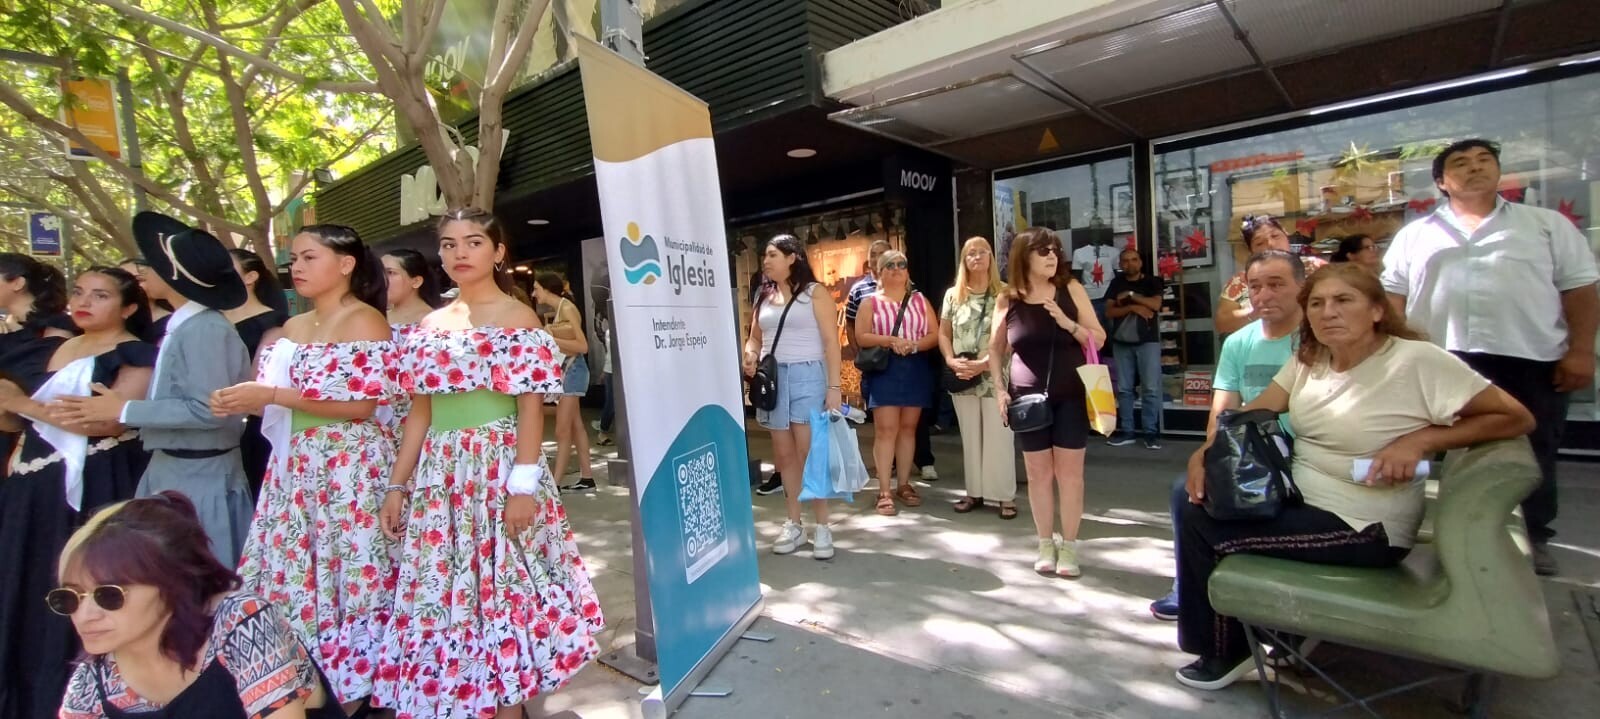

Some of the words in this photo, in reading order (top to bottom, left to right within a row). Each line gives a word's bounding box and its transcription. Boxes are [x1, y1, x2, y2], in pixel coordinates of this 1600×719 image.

[900, 169, 937, 191] MOOV
[664, 236, 706, 255] Municipalidad
[667, 253, 715, 296] Iglesia
[652, 316, 686, 331] Intendente
[654, 334, 668, 349] Dr.
[669, 334, 686, 351] Jorge
[686, 332, 708, 350] Espejo
[1186, 380, 1209, 390] 20%
